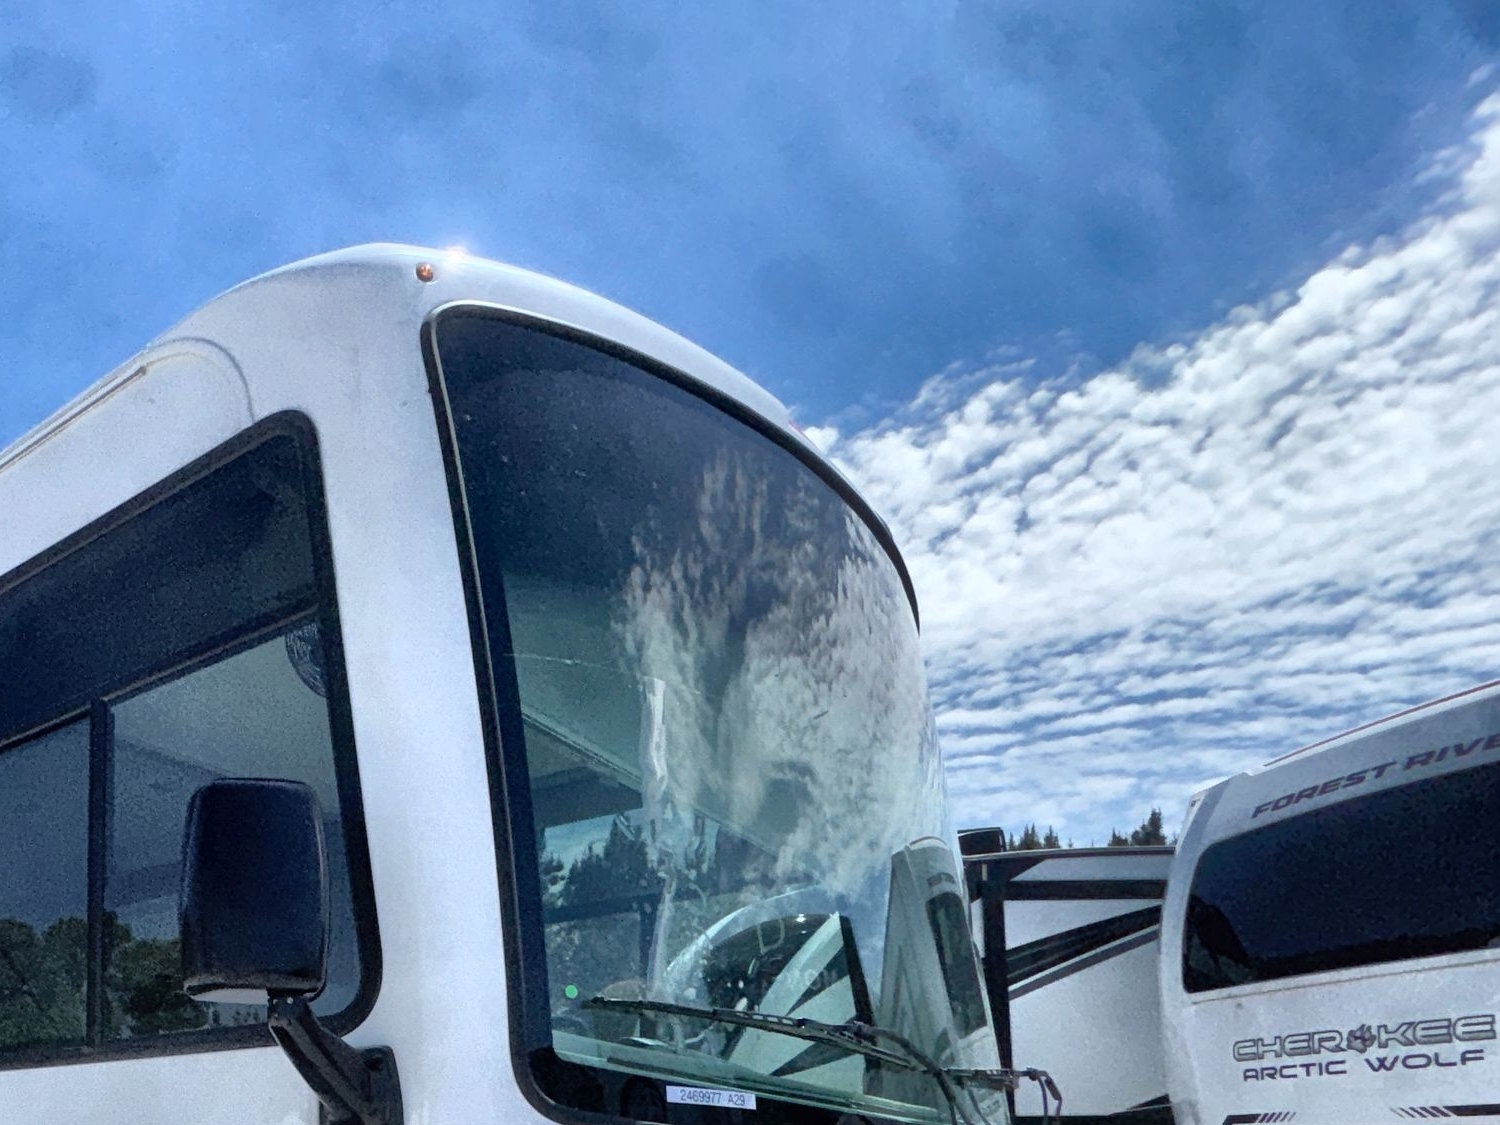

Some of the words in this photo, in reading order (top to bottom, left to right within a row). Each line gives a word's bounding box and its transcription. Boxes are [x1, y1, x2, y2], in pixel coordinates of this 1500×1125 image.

[1252, 760, 1397, 820] FOREST
[1243, 1060, 1348, 1082] ARCTIC
[1365, 1049, 1485, 1073] WOLF
[679, 1088, 722, 1104] 2469977
[727, 1093, 746, 1107] A29
